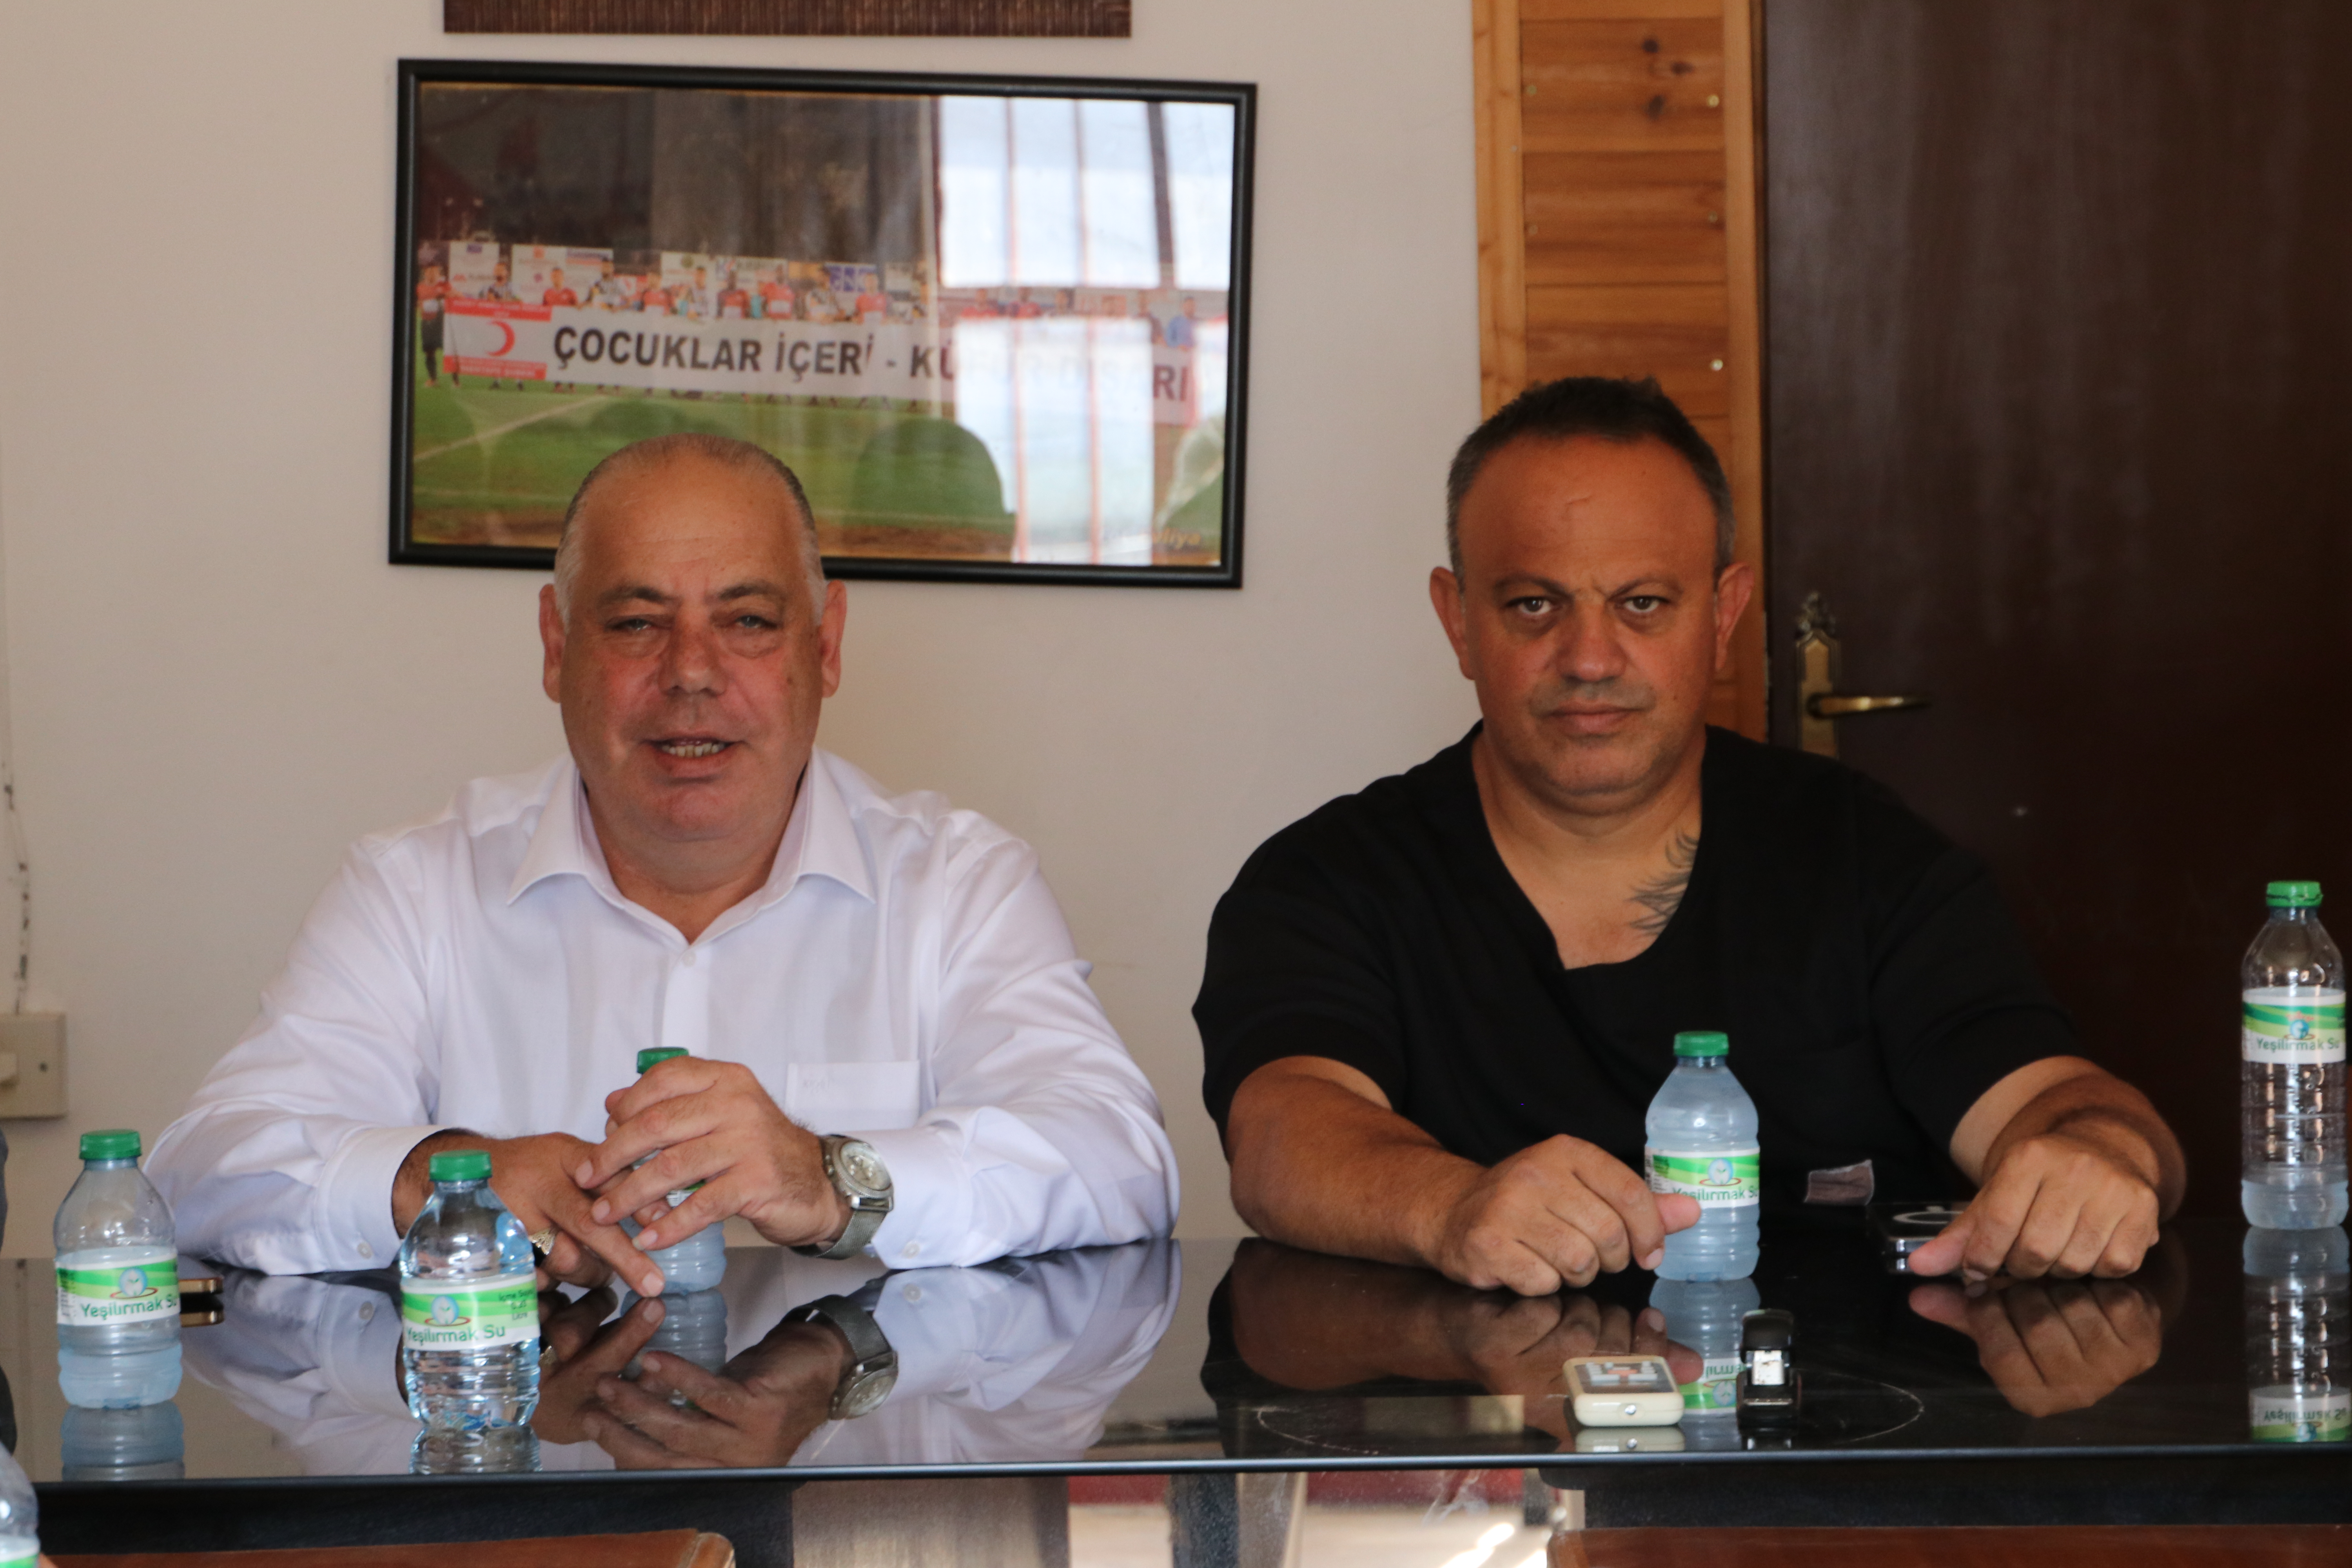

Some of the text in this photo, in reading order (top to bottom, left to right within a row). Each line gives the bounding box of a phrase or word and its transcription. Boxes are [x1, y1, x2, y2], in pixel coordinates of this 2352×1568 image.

[554, 326, 762, 371] ÇOCUKLAR
[80, 1298, 163, 1320] Yeşilırmak
[406, 1324, 505, 1346] Yeşilırmak Su
